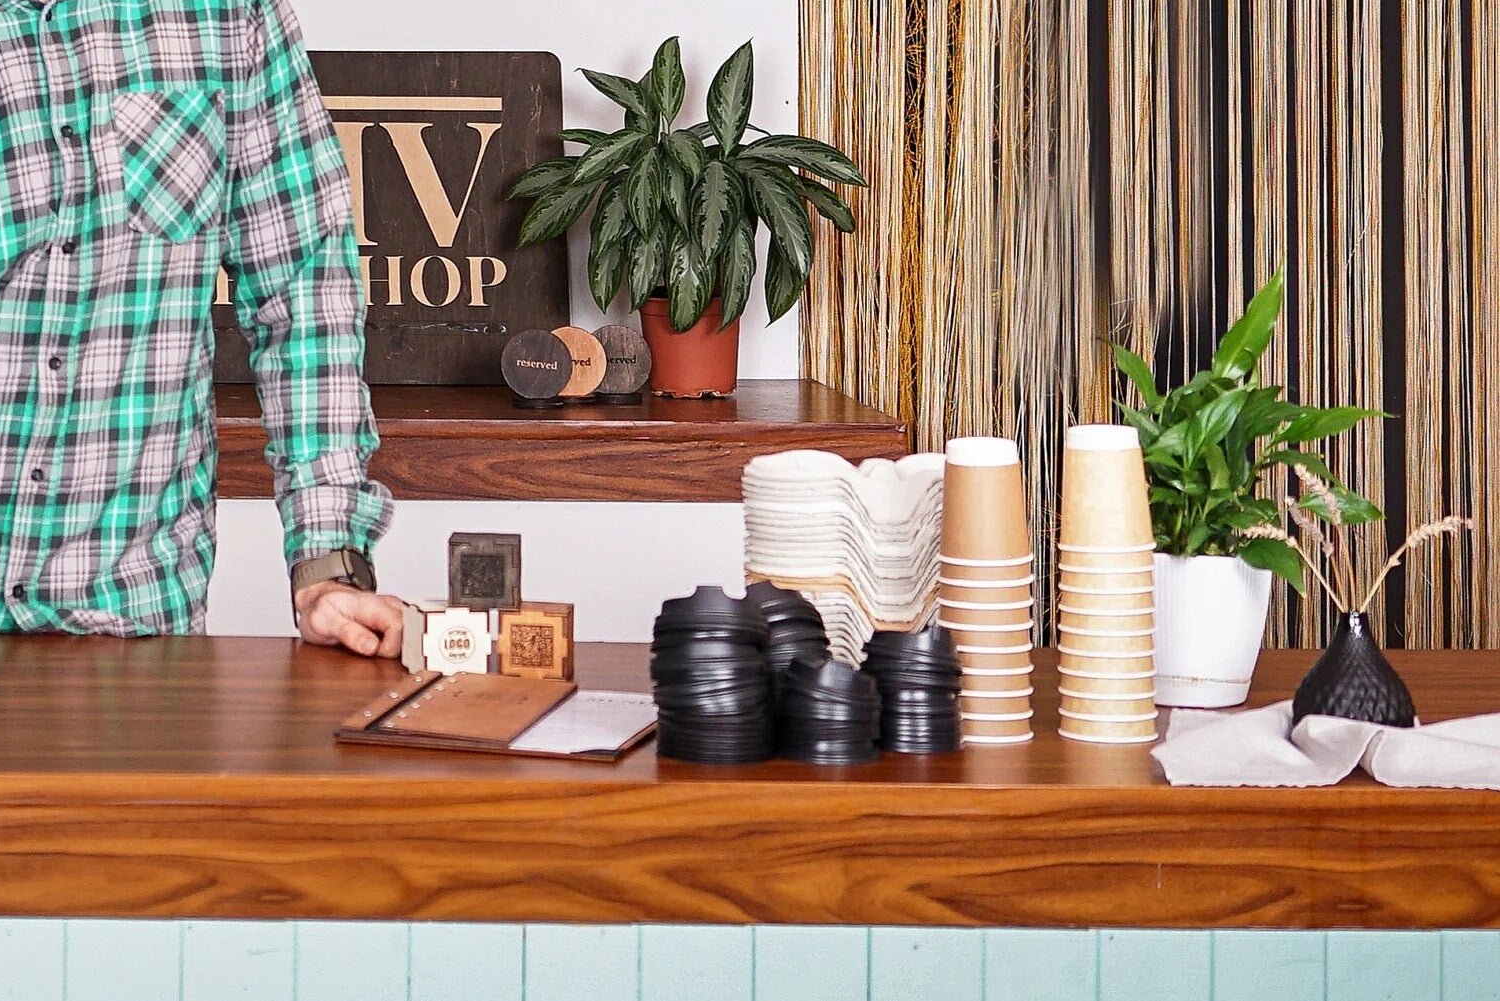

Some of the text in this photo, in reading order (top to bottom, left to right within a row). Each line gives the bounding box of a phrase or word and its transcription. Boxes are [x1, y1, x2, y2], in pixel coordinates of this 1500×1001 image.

[358, 255, 507, 308] HOP
[516, 359, 558, 370] reserved
[608, 355, 636, 364] erved
